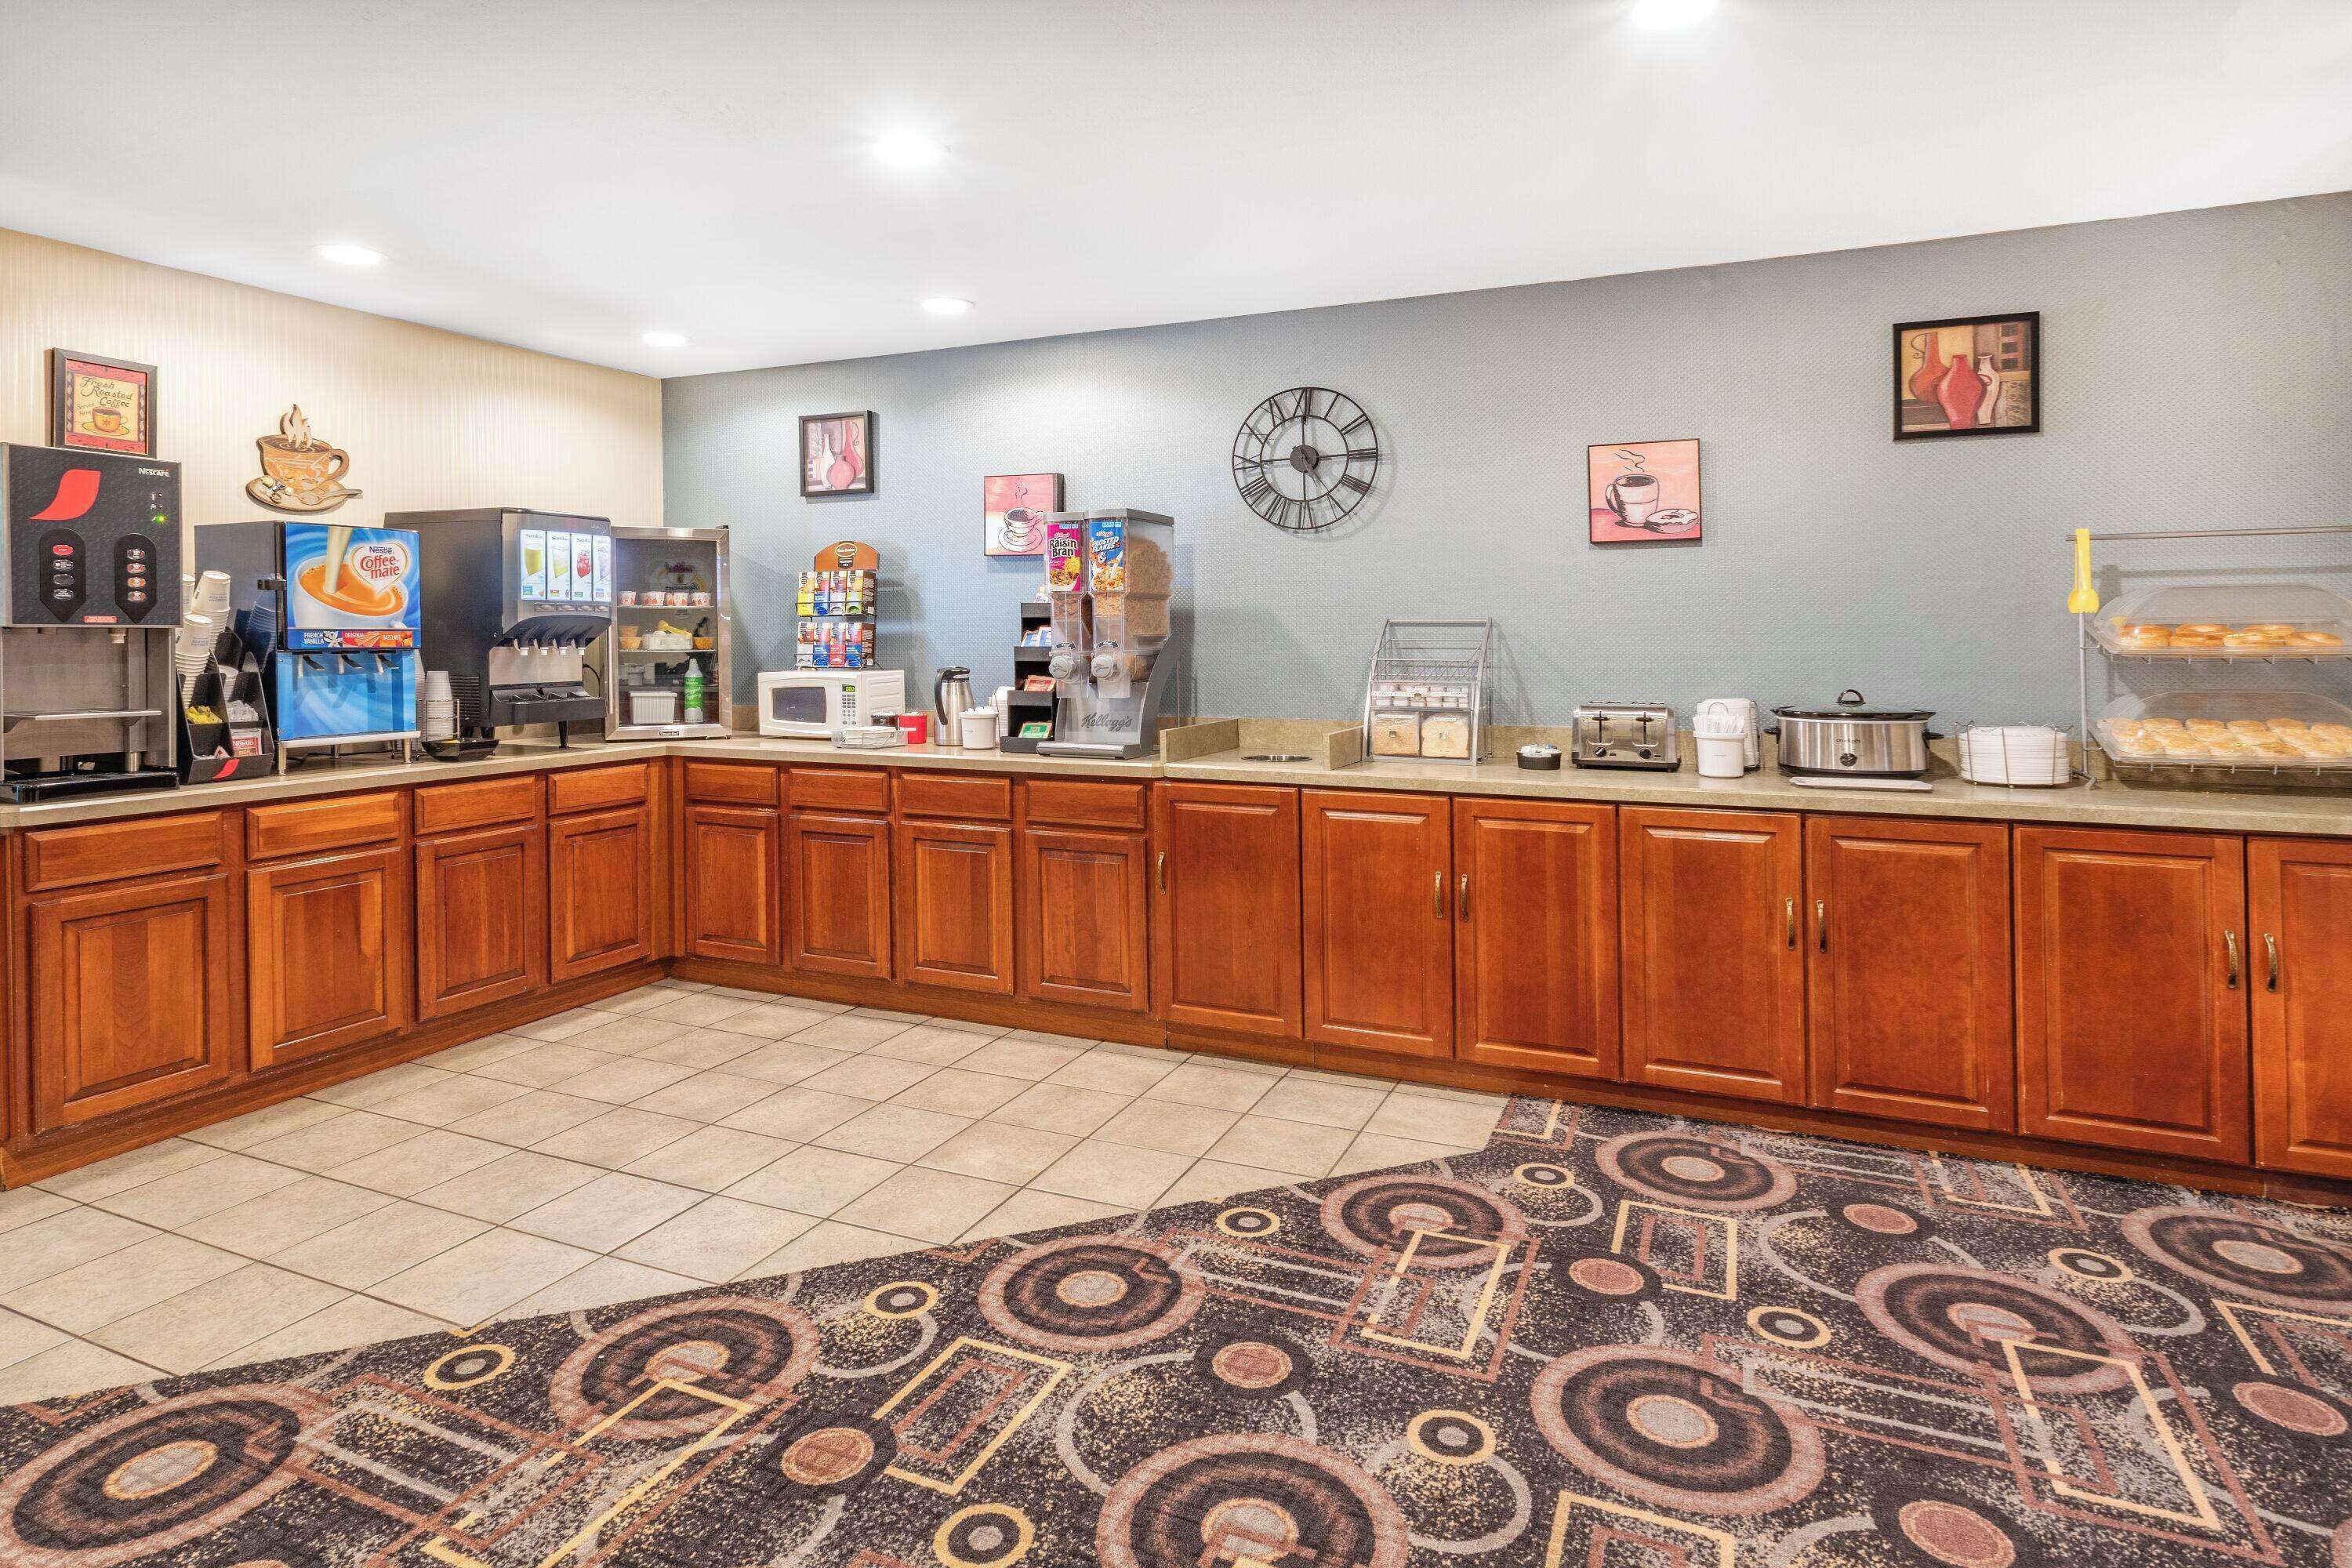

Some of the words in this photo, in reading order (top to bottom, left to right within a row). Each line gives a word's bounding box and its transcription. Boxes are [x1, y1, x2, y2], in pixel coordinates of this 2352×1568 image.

[79, 376, 115, 389] Fresh
[81, 387, 132, 401] Roasted
[100, 397, 130, 408] Coffee
[1049, 538, 1077, 549] Raisin
[1091, 536, 1120, 547] FROSTED
[1052, 548, 1074, 557] Bran
[370, 565, 400, 579] mate
[1081, 712, 1133, 731] Kellogg's
